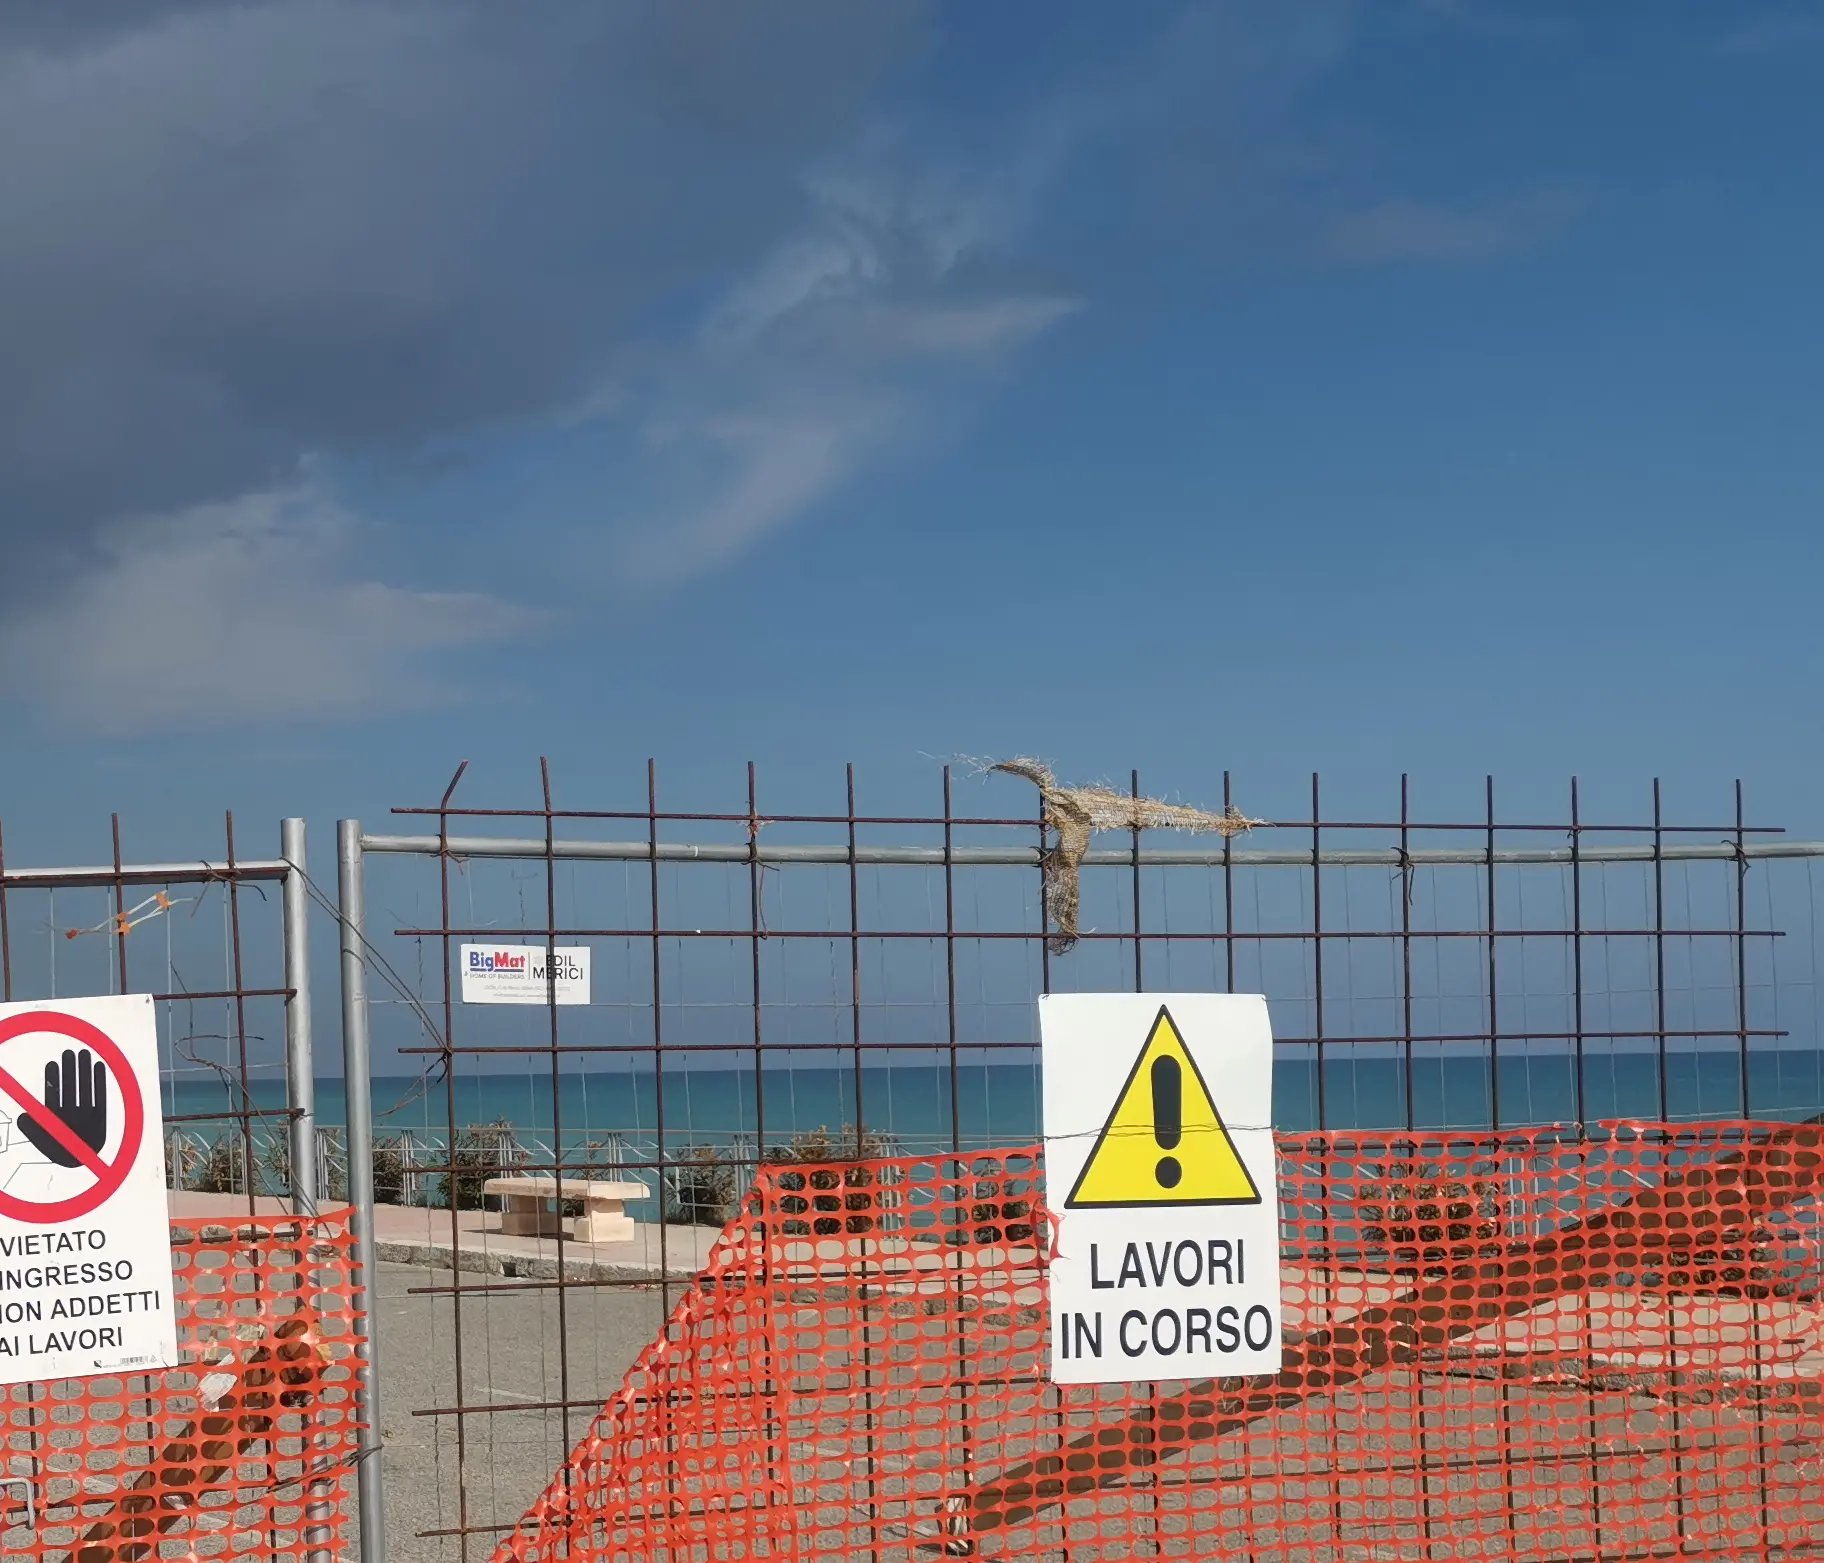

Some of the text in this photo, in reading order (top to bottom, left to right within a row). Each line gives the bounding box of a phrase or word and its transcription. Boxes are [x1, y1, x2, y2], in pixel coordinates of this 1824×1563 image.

[470, 952, 526, 972] BigMat
[533, 967, 583, 980] MERICI
[0, 1229, 106, 1257] VIETATO
[1090, 1239, 1245, 1289] LAVORI
[50, 1290, 160, 1320] ADDETTI
[29, 1326, 123, 1355] LAVORI
[1061, 1304, 1272, 1359] IN CORSO
